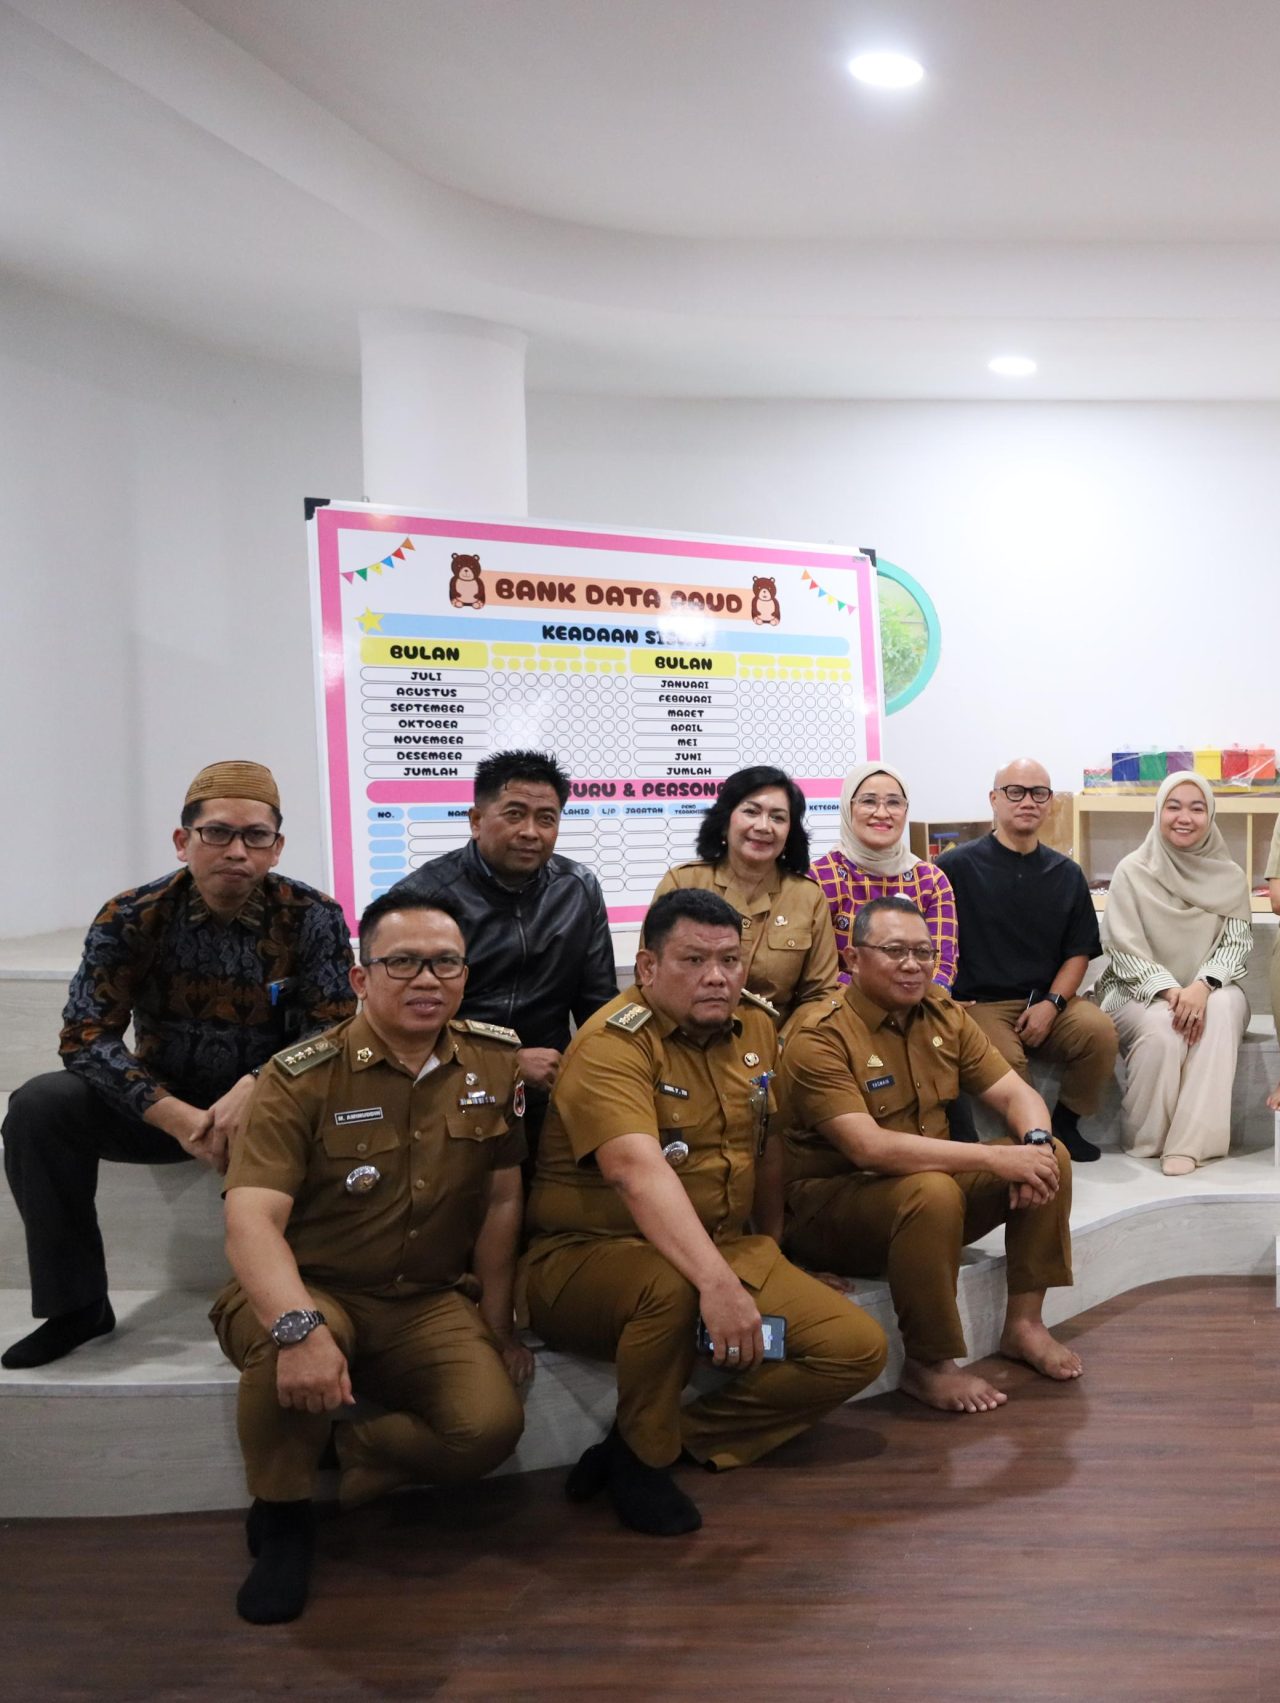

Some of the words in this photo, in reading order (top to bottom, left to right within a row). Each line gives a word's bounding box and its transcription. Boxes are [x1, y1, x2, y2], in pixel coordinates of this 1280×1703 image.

[495, 578, 576, 603] BANK
[585, 584, 661, 608] DATA
[670, 589, 743, 614] PAUD
[542, 624, 639, 644] KEADAAN
[389, 645, 460, 661] BULAN
[654, 656, 713, 671] BULAN
[410, 671, 442, 681] JULI
[660, 680, 709, 690] JANUARI
[396, 687, 458, 698] AGUSTUS
[658, 694, 712, 704] FEBRUARI
[390, 703, 465, 714] SEPTEMBER
[667, 709, 705, 718] MARET
[398, 719, 458, 729] OKTOBER
[670, 723, 703, 732] APRIL
[393, 735, 464, 745] NOVEMBER
[677, 738, 698, 747] MEI
[396, 751, 463, 761] DESEMBER
[674, 752, 702, 761] JUNI
[403, 767, 458, 776] JUMLAH
[666, 767, 712, 776] JUMLAH
[569, 782, 617, 798] URU
[623, 782, 636, 797] &
[642, 782, 726, 797] PERSONA
[563, 808, 590, 816] LAHIR
[601, 808, 616, 816] L/P
[625, 807, 664, 815] JABATAN
